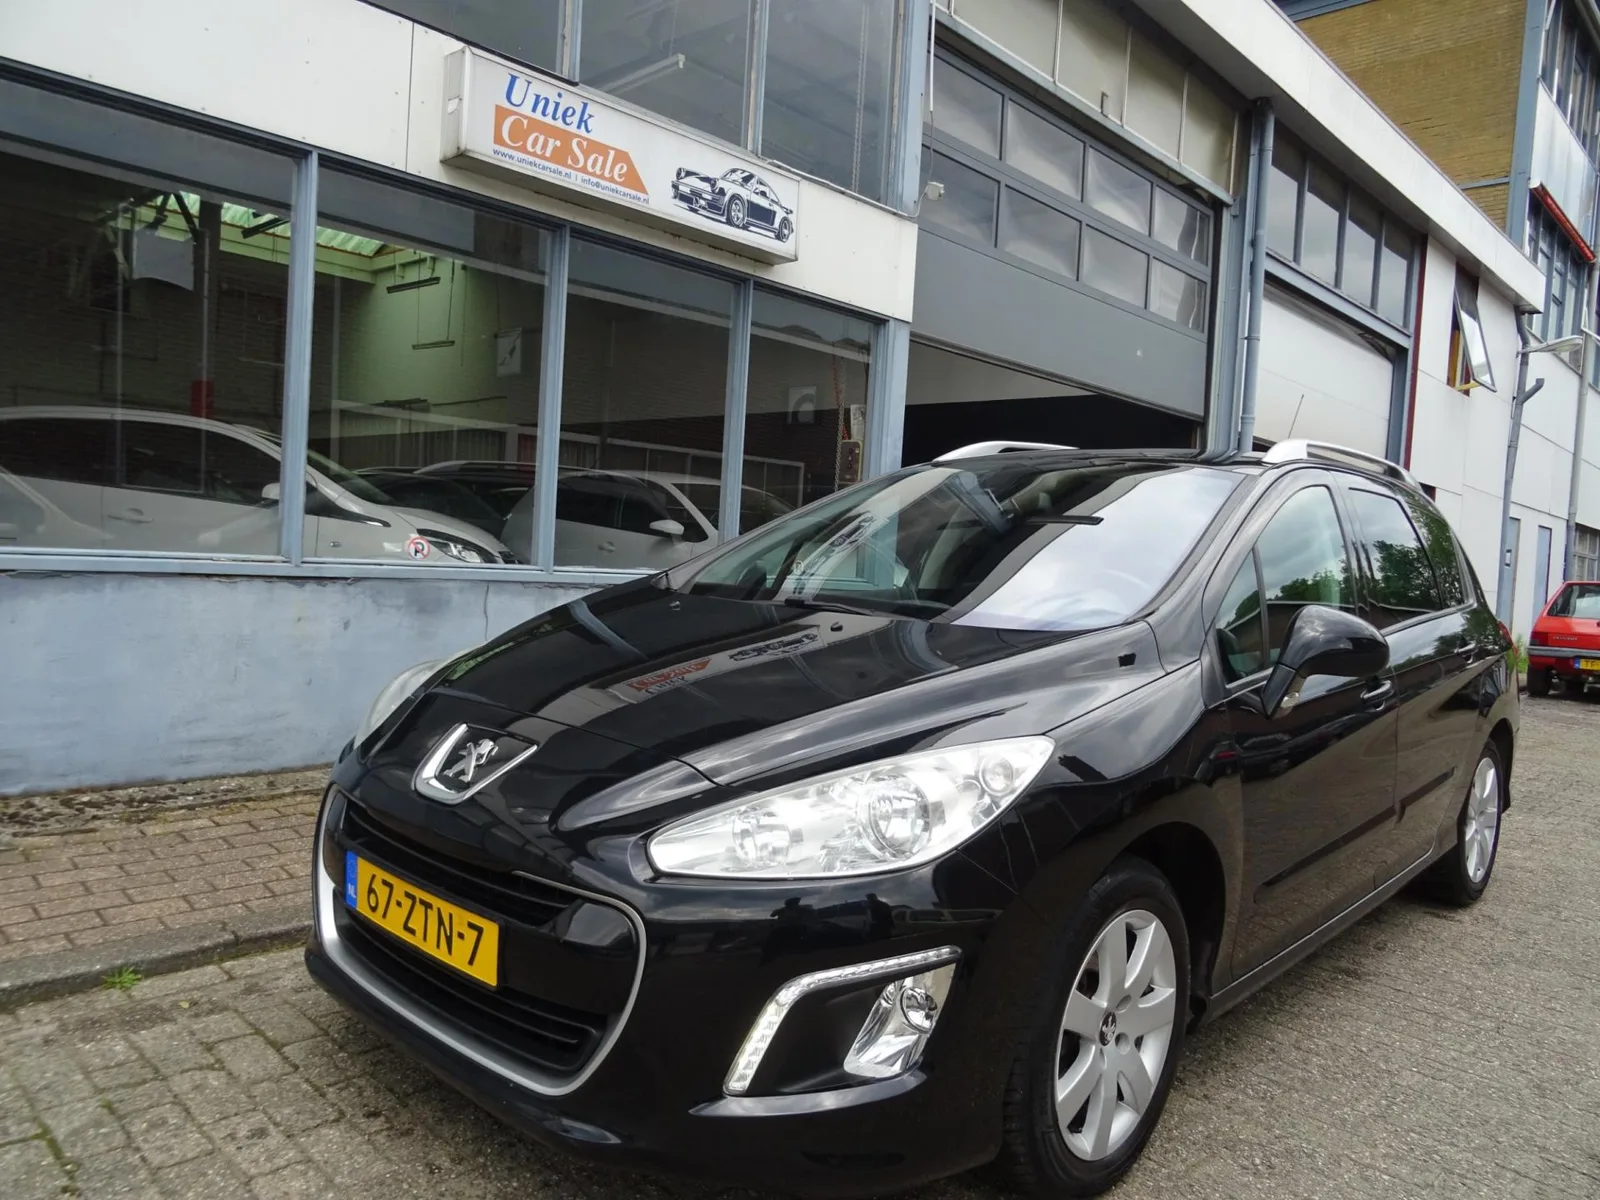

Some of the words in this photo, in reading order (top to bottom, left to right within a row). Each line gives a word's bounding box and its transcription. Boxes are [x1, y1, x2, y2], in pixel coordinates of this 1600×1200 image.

[505, 73, 594, 134] Uniek
[493, 149, 572, 180] www.uniekcarsale.nl
[581, 176, 650, 205] info@uniekcarsale.nl
[501, 115, 561, 158] Car
[567, 137, 628, 182] Sale
[366, 873, 485, 966] 67-ZTN-7
